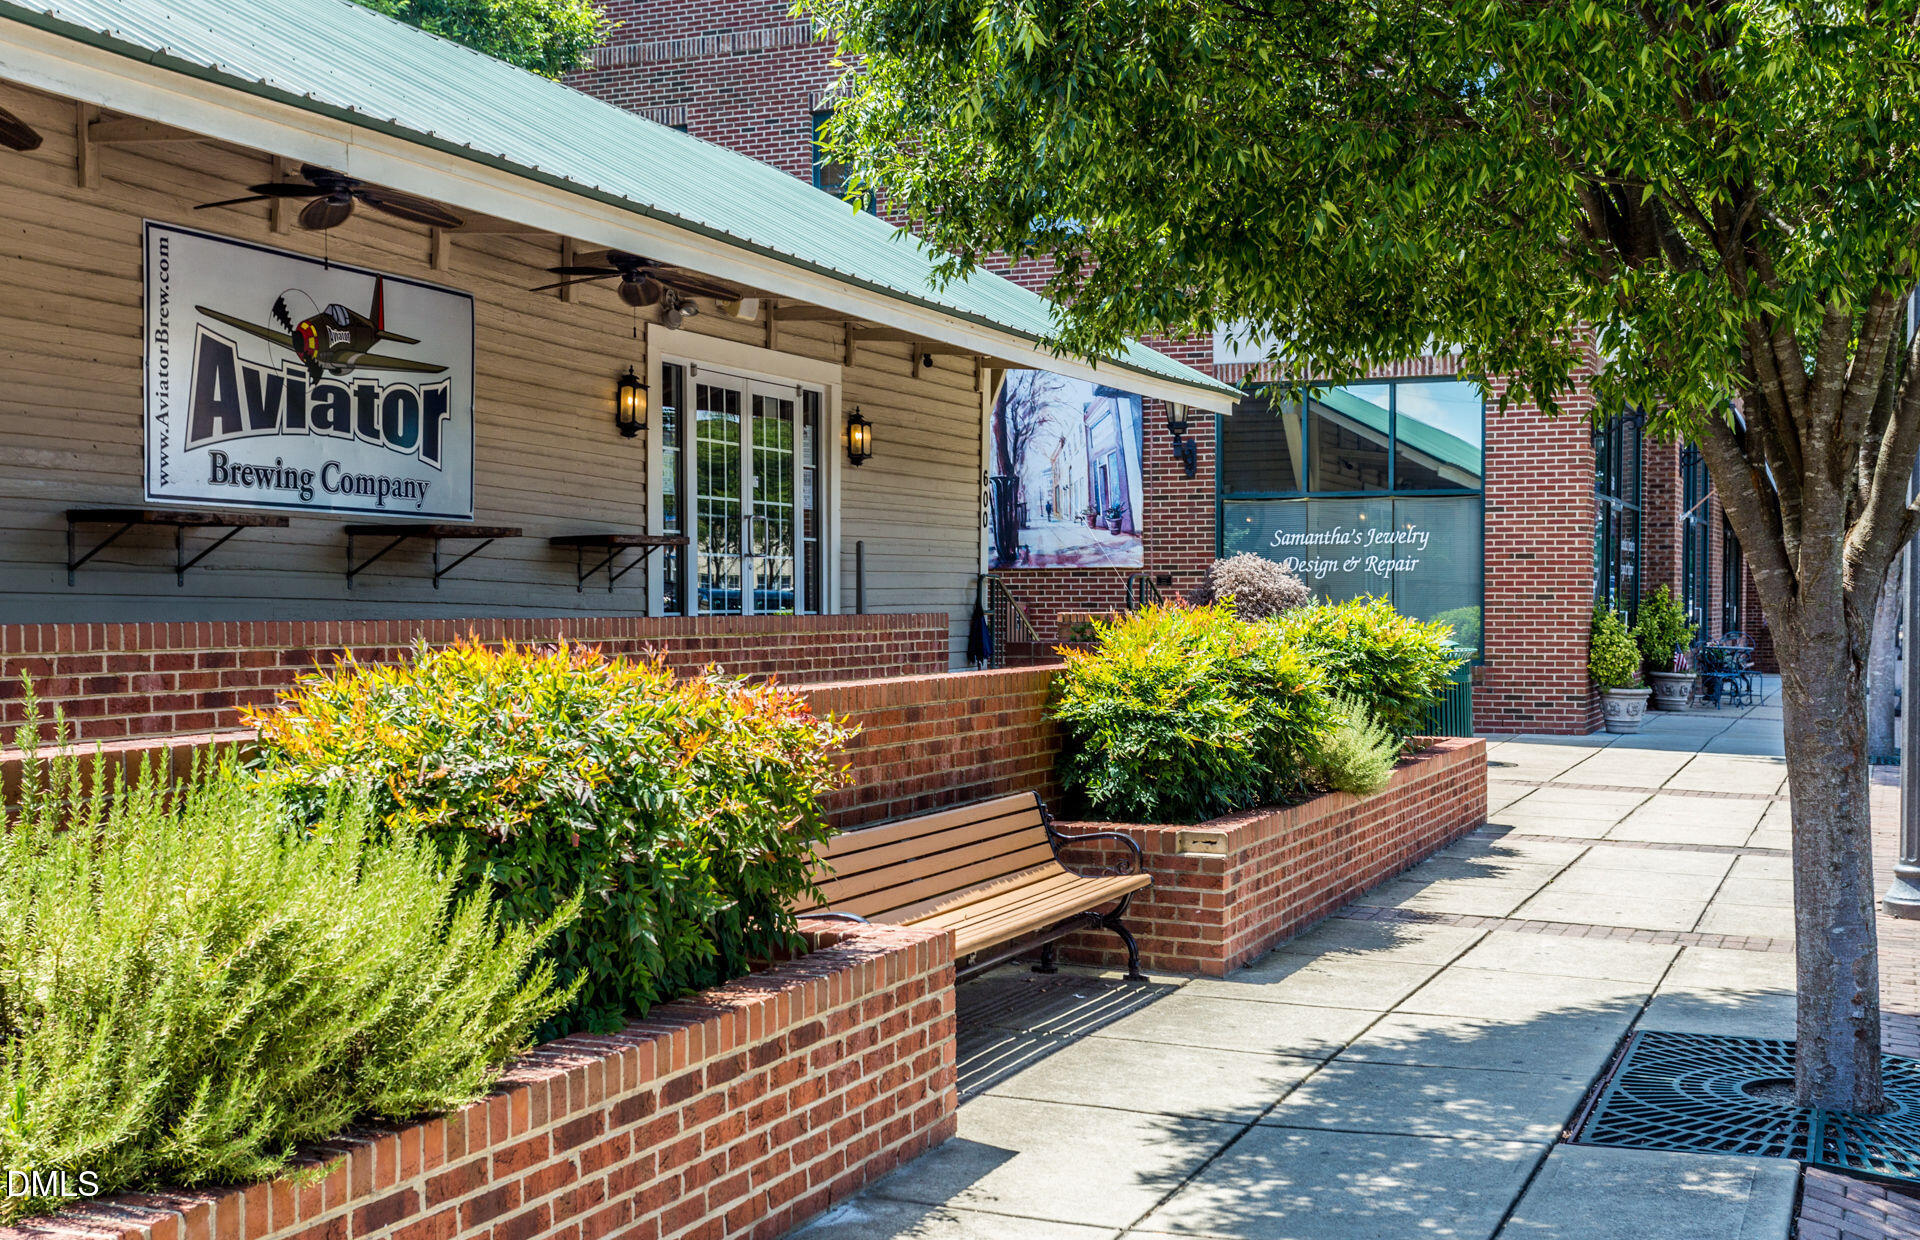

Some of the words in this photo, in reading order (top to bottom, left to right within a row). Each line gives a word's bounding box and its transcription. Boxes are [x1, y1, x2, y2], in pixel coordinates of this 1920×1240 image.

[154, 236, 170, 488] www.AviatorBrew.com
[184, 323, 452, 471] Aviator
[209, 450, 315, 501] Brewing
[321, 461, 430, 510] Company
[1270, 526, 1363, 548] Samantha's
[1364, 525, 1430, 551] Jewelry
[1285, 555, 1339, 579] Design
[1343, 556, 1362, 573] &
[1364, 556, 1419, 578] Repair
